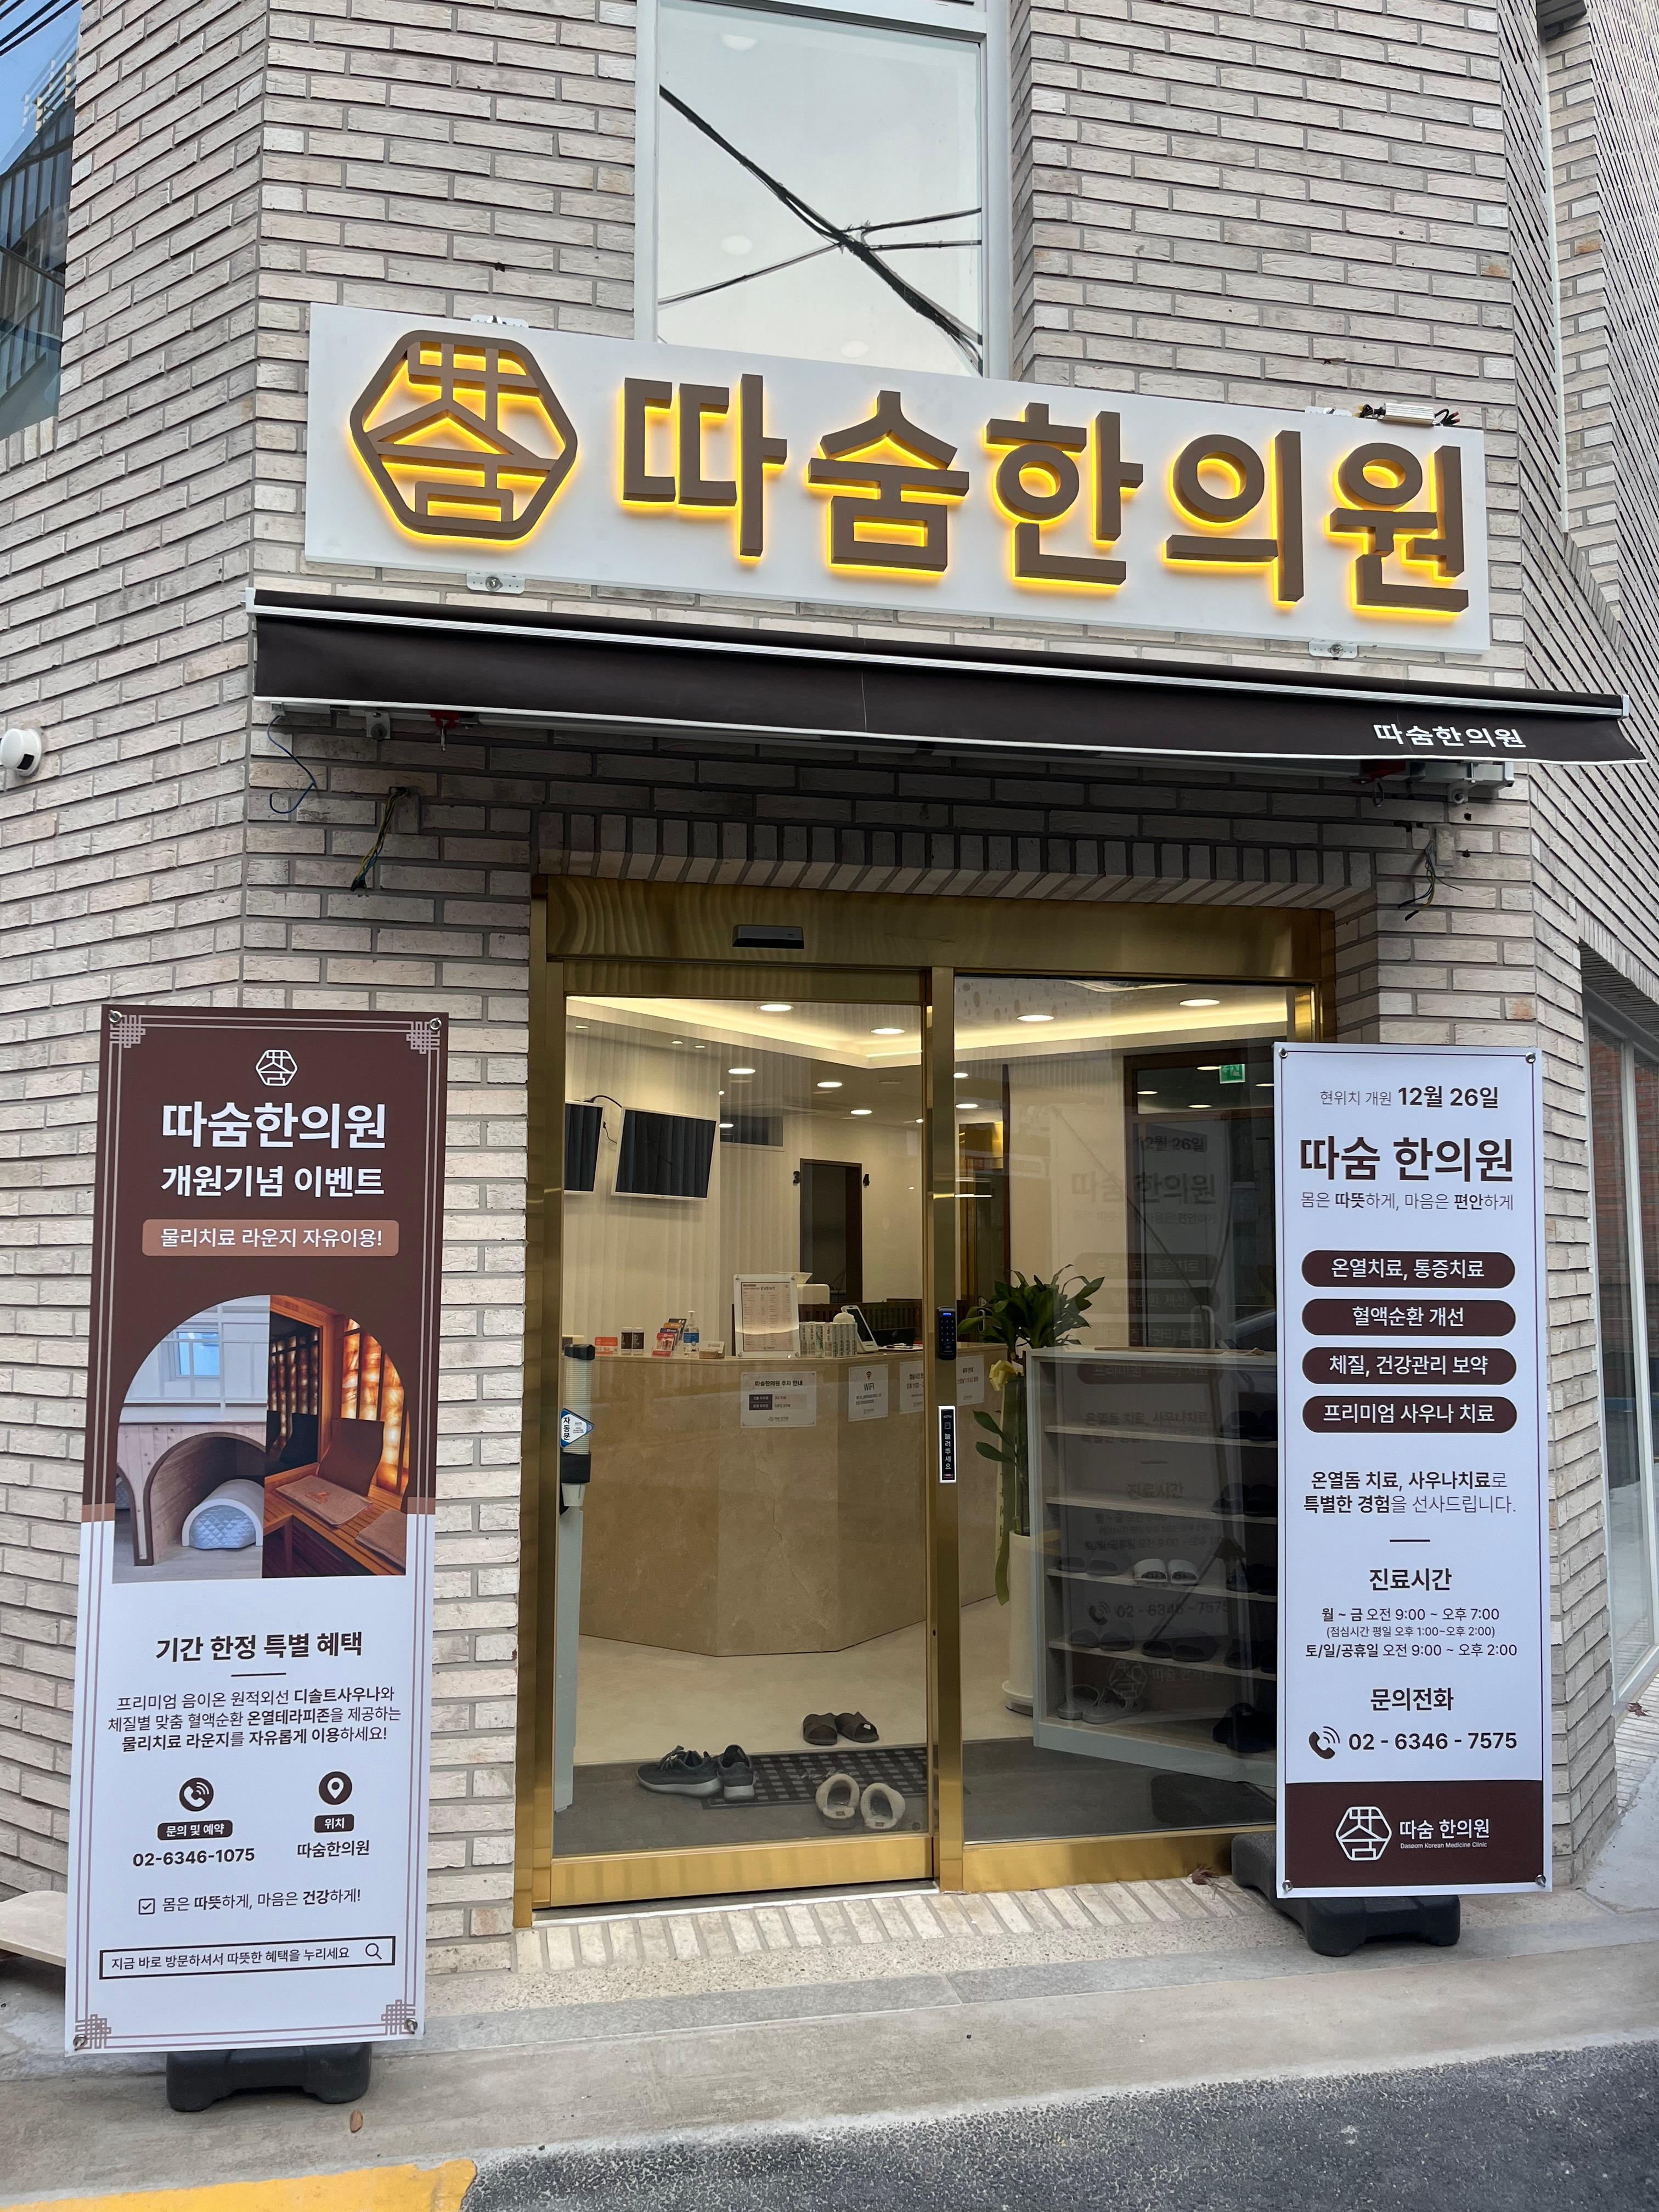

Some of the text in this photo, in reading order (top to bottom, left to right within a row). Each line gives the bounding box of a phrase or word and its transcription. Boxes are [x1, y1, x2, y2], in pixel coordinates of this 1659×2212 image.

[623, 374, 1469, 612] 따숨한의원
[1374, 724, 1526, 747] 따숨한의원
[1321, 1086, 1498, 1108] 현위치 개원 12월 26일
[163, 1102, 385, 1148] 따숨한의원
[1301, 1136, 1513, 1182] 따숨 한의원
[161, 1165, 384, 1197] 개원기념 이벤트
[1301, 1192, 1513, 1211] 몸은 따뜻하게, 마음은 편안하게
[161, 1228, 381, 1247] 물리치료 라운지 자유이용!
[1331, 1259, 1484, 1280] 온열치료, 통증치료
[1352, 1306, 1463, 1327] 혈액순환 개선
[1330, 1355, 1488, 1377] 체질, 건강관리 보약
[1324, 1404, 1494, 1423] 프리미엄 사우나 치료
[1312, 1471, 1507, 1491] 온열돔 치료, 사우나치료로
[1304, 1495, 1515, 1513] 특별한 경험을 선사드립니다.
[1370, 1568, 1452, 1591] 진료시간
[1322, 1608, 1333, 1622] 월
[1351, 1609, 1362, 1621] 금
[1367, 1608, 1390, 1621] 오전
[1396, 1609, 1425, 1620] 9:00
[1442, 1607, 1466, 1621] 오후
[1471, 1609, 1499, 1620] 7:00
[1327, 1627, 1369, 1639] (점심시간
[1373, 1626, 1391, 1637] 평일
[1395, 1626, 1413, 1637] 오후
[156, 1632, 362, 1662] 기간 한정 특별 혜택
[1306, 1644, 1378, 1658] 토/일/공휴일
[1383, 1644, 1407, 1657] 오전
[1412, 1645, 1441, 1656] 9:00
[1459, 1643, 1483, 1656] 오후
[1488, 1644, 1517, 1655] 2:00
[117, 1686, 394, 1710] 프리미엄 음이온 원적외선 디솔트사우나와
[1371, 1688, 1454, 1711] 문의전화
[108, 1706, 400, 1732] 체질별 맞춤 혈액순환 온열테라피존을 제공하는
[122, 1726, 386, 1752] 물리치료 라운지를 자유롭게 이용하세요!
[1349, 1734, 1374, 1750] 02
[1395, 1733, 1447, 1750] 6346
[1468, 1733, 1516, 1748] 7575
[166, 1824, 224, 1837] 문의 및 예약
[325, 1818, 344, 1829] 위치
[1400, 1819, 1489, 1839] 따숨 한의원
[133, 1848, 254, 1866] 02-6346-1075
[297, 1840, 369, 1858] 따숨한의원
[163, 1888, 360, 1911] 몸은 따뜻하게, 마음은 건강하게!
[112, 1948, 349, 1970] 지금 바로 방문하셔서 따뜻한 혜택을 누리세요
